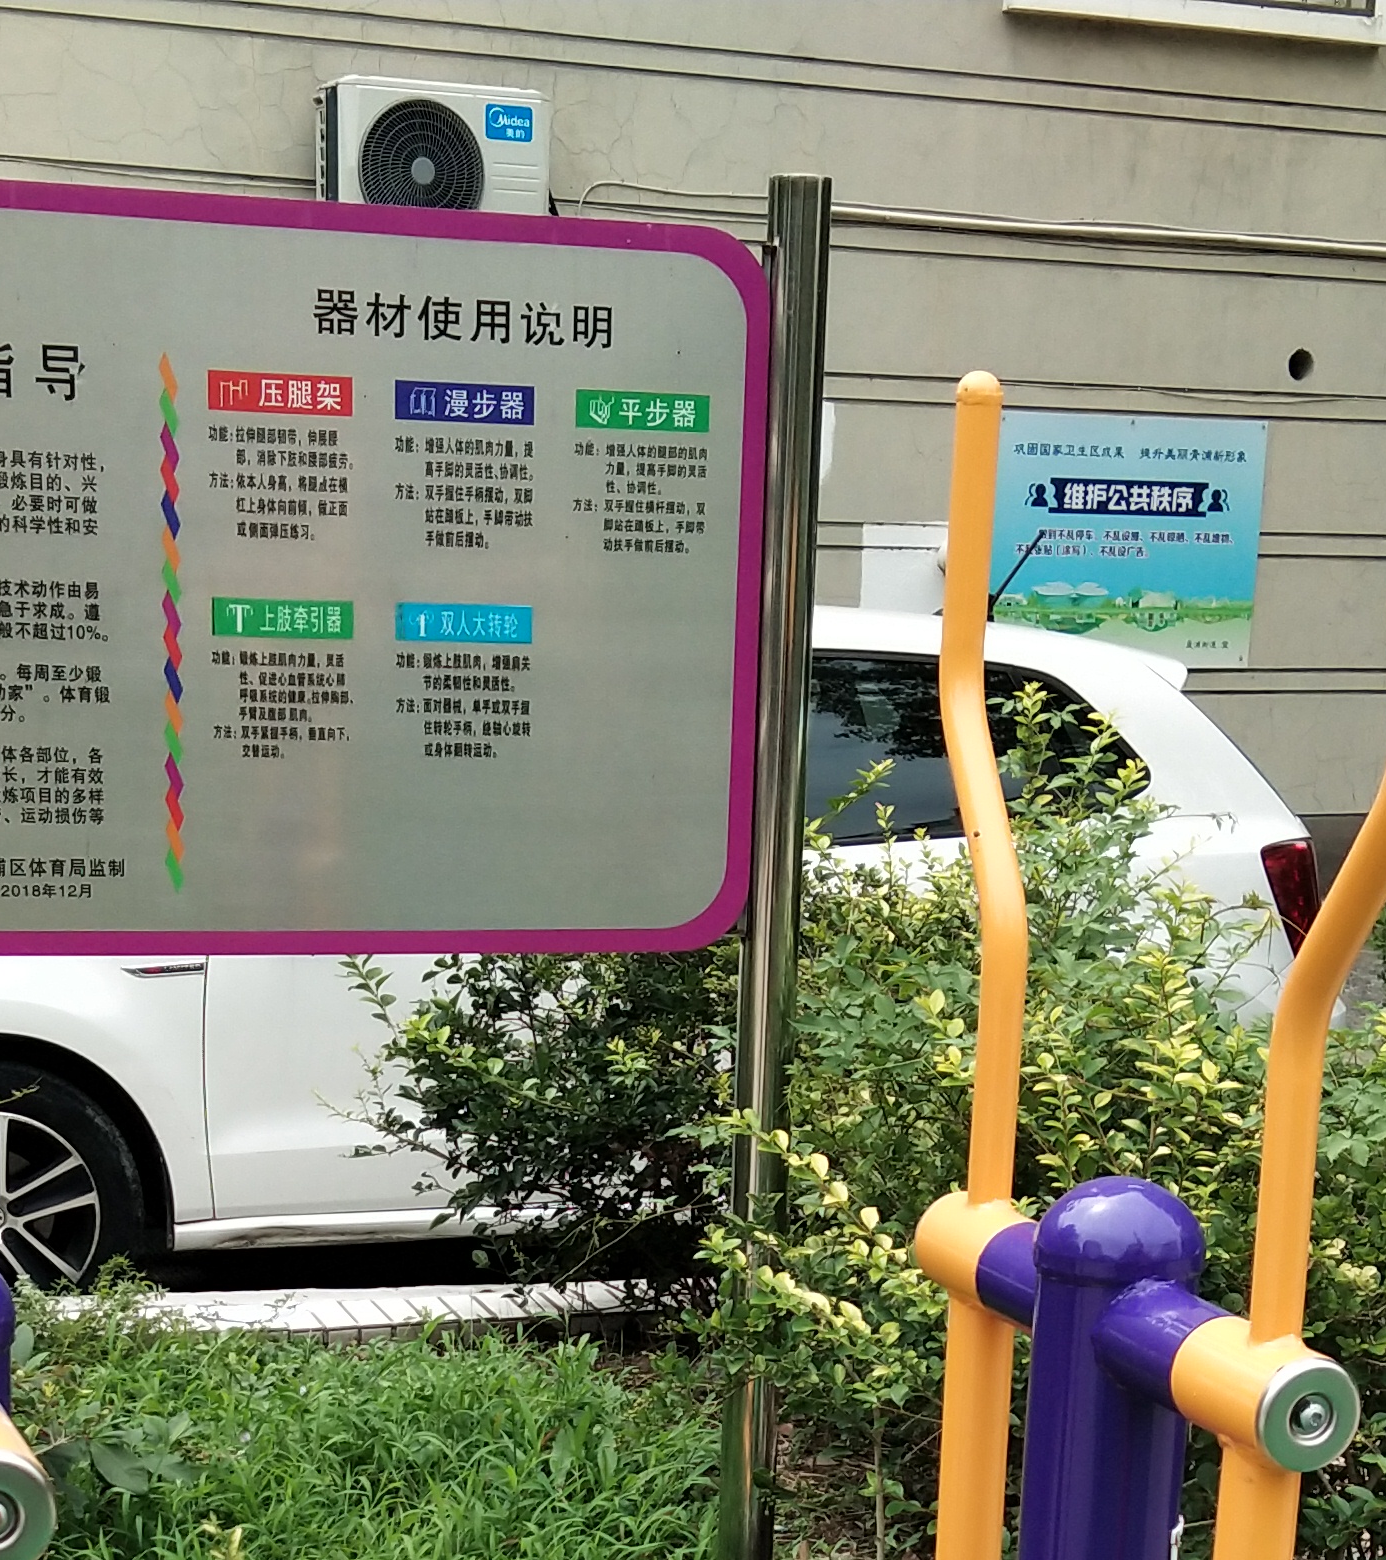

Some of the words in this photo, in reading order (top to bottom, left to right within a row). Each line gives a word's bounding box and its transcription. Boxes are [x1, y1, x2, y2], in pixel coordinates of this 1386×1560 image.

[492, 109, 530, 128] Midea
[506, 127, 526, 139] 美的
[313, 288, 613, 348] 器材使用说明
[259, 379, 342, 411] 压腿架
[444, 389, 525, 420] 漫步器
[619, 398, 696, 428] 平步器
[1063, 482, 1194, 513] 维护公共秩序
[259, 604, 342, 633] 上肢牵引器
[440, 609, 519, 639] 双人大转轮
[0, 883, 93, 899] 2018年12月
